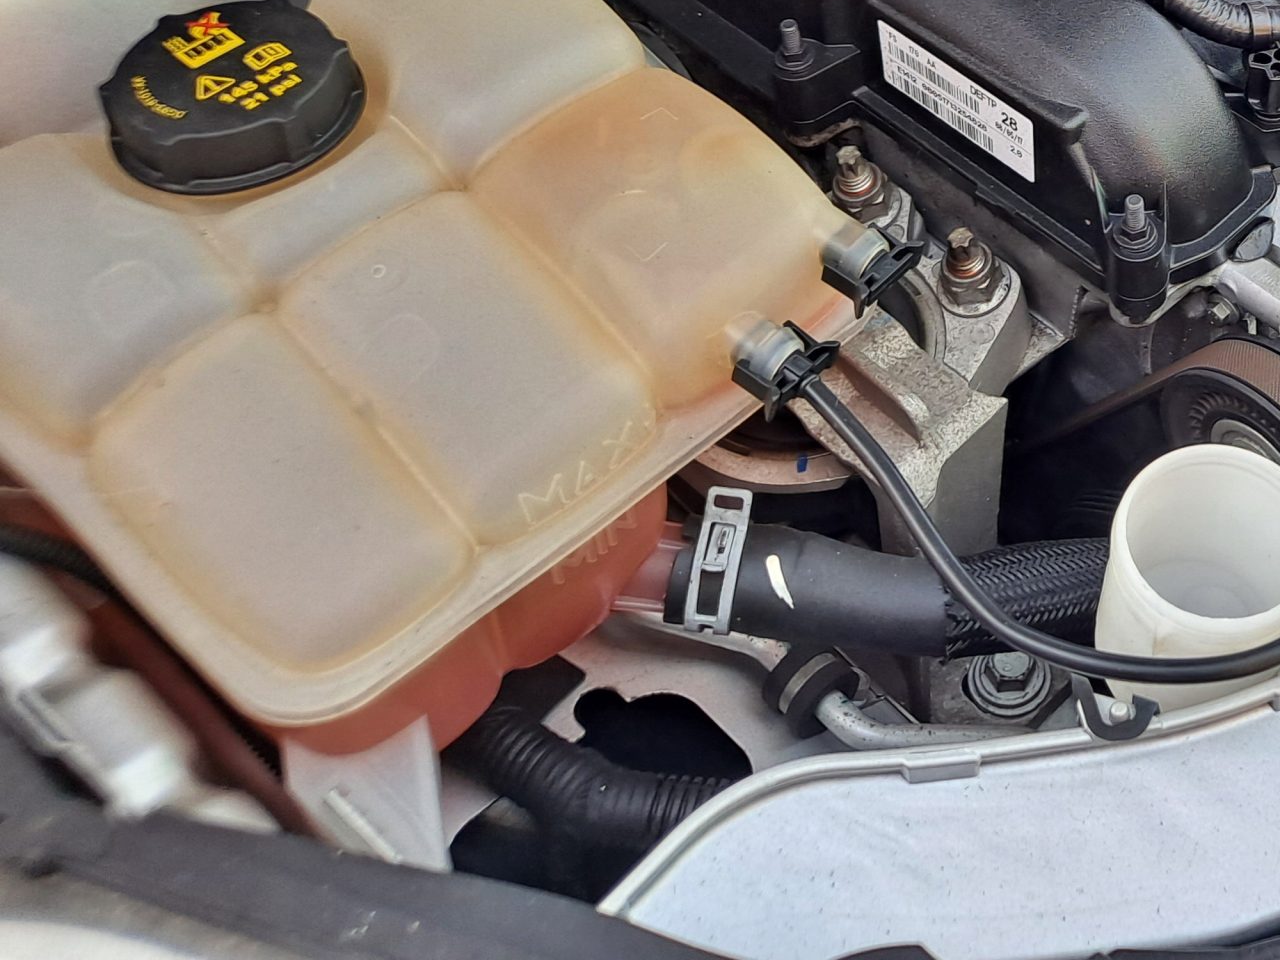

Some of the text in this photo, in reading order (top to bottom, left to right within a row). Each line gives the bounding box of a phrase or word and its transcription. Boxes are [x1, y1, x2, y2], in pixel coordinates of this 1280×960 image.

[239, 91, 271, 111] 21
[1000, 111, 1019, 132] 28
[517, 420, 635, 528] MAX
